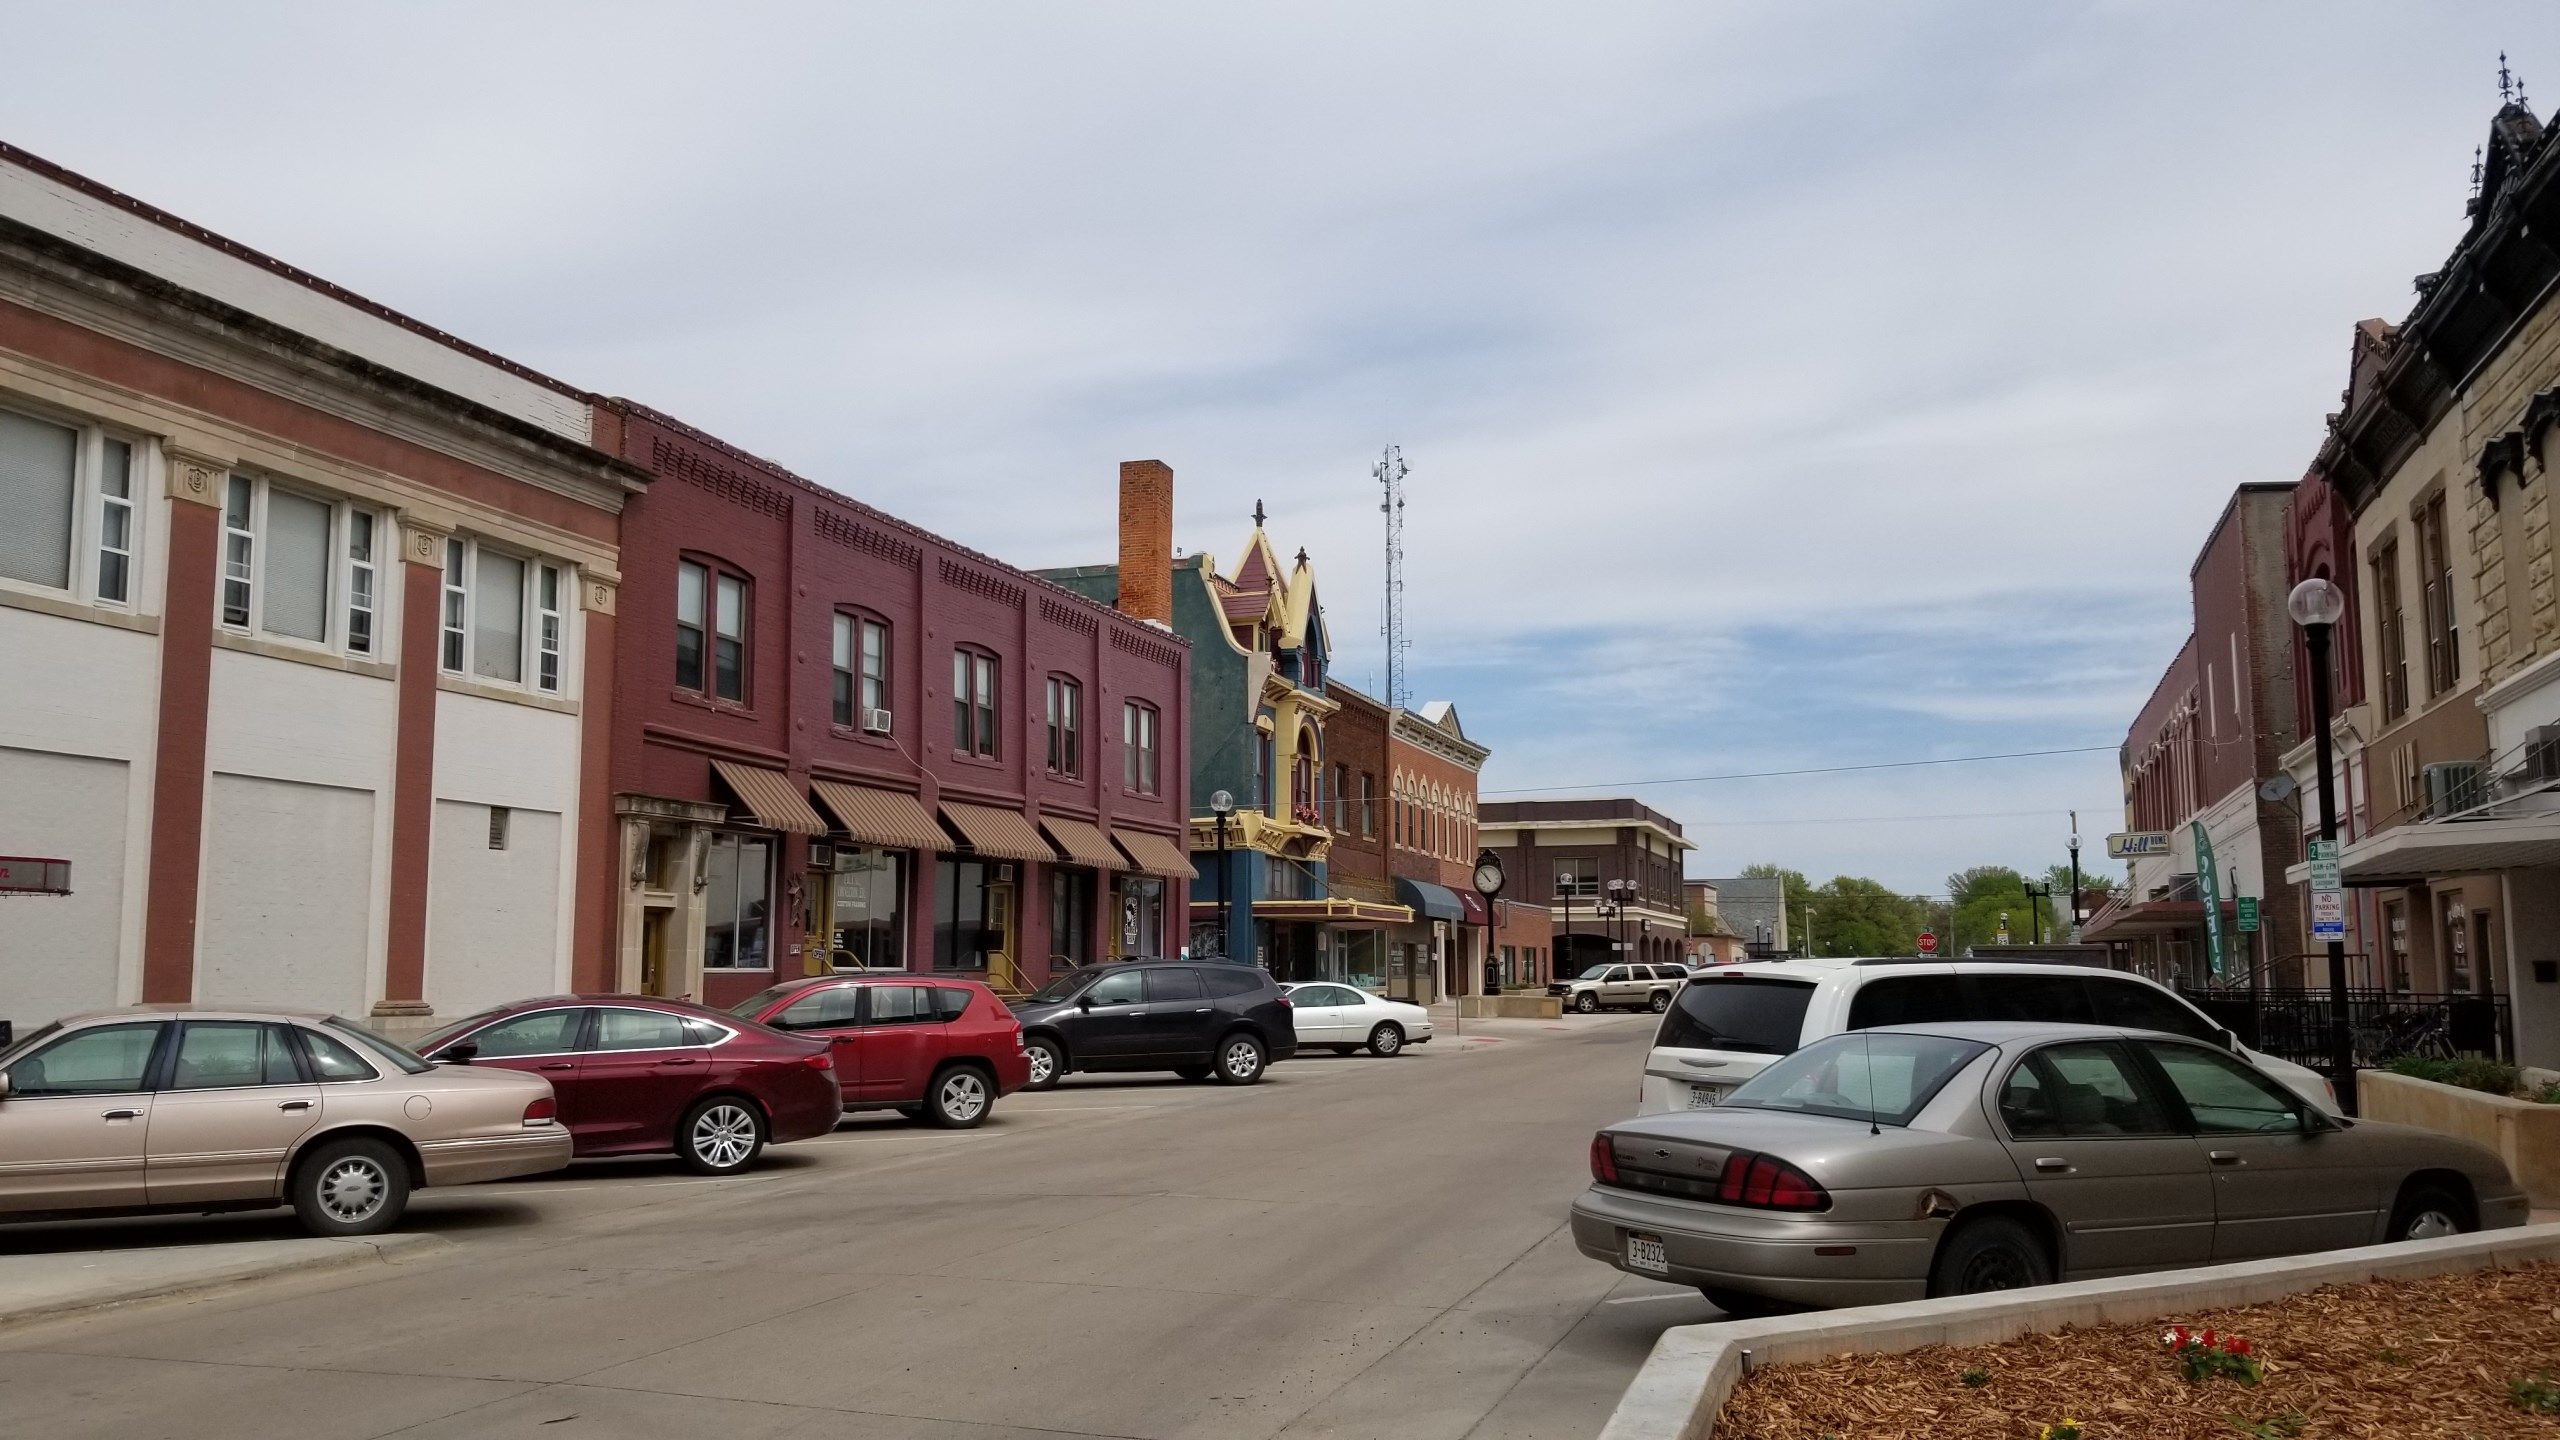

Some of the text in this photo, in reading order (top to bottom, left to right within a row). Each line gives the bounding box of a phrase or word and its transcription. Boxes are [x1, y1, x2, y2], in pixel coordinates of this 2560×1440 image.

[2391, 742, 2415, 809] VIP
[2114, 836, 2149, 853] Hill
[2310, 845, 2317, 858] 2
[2321, 895, 2332, 903] NO
[1918, 938, 1936, 947] STOP
[814, 949, 824, 958] OPEN
